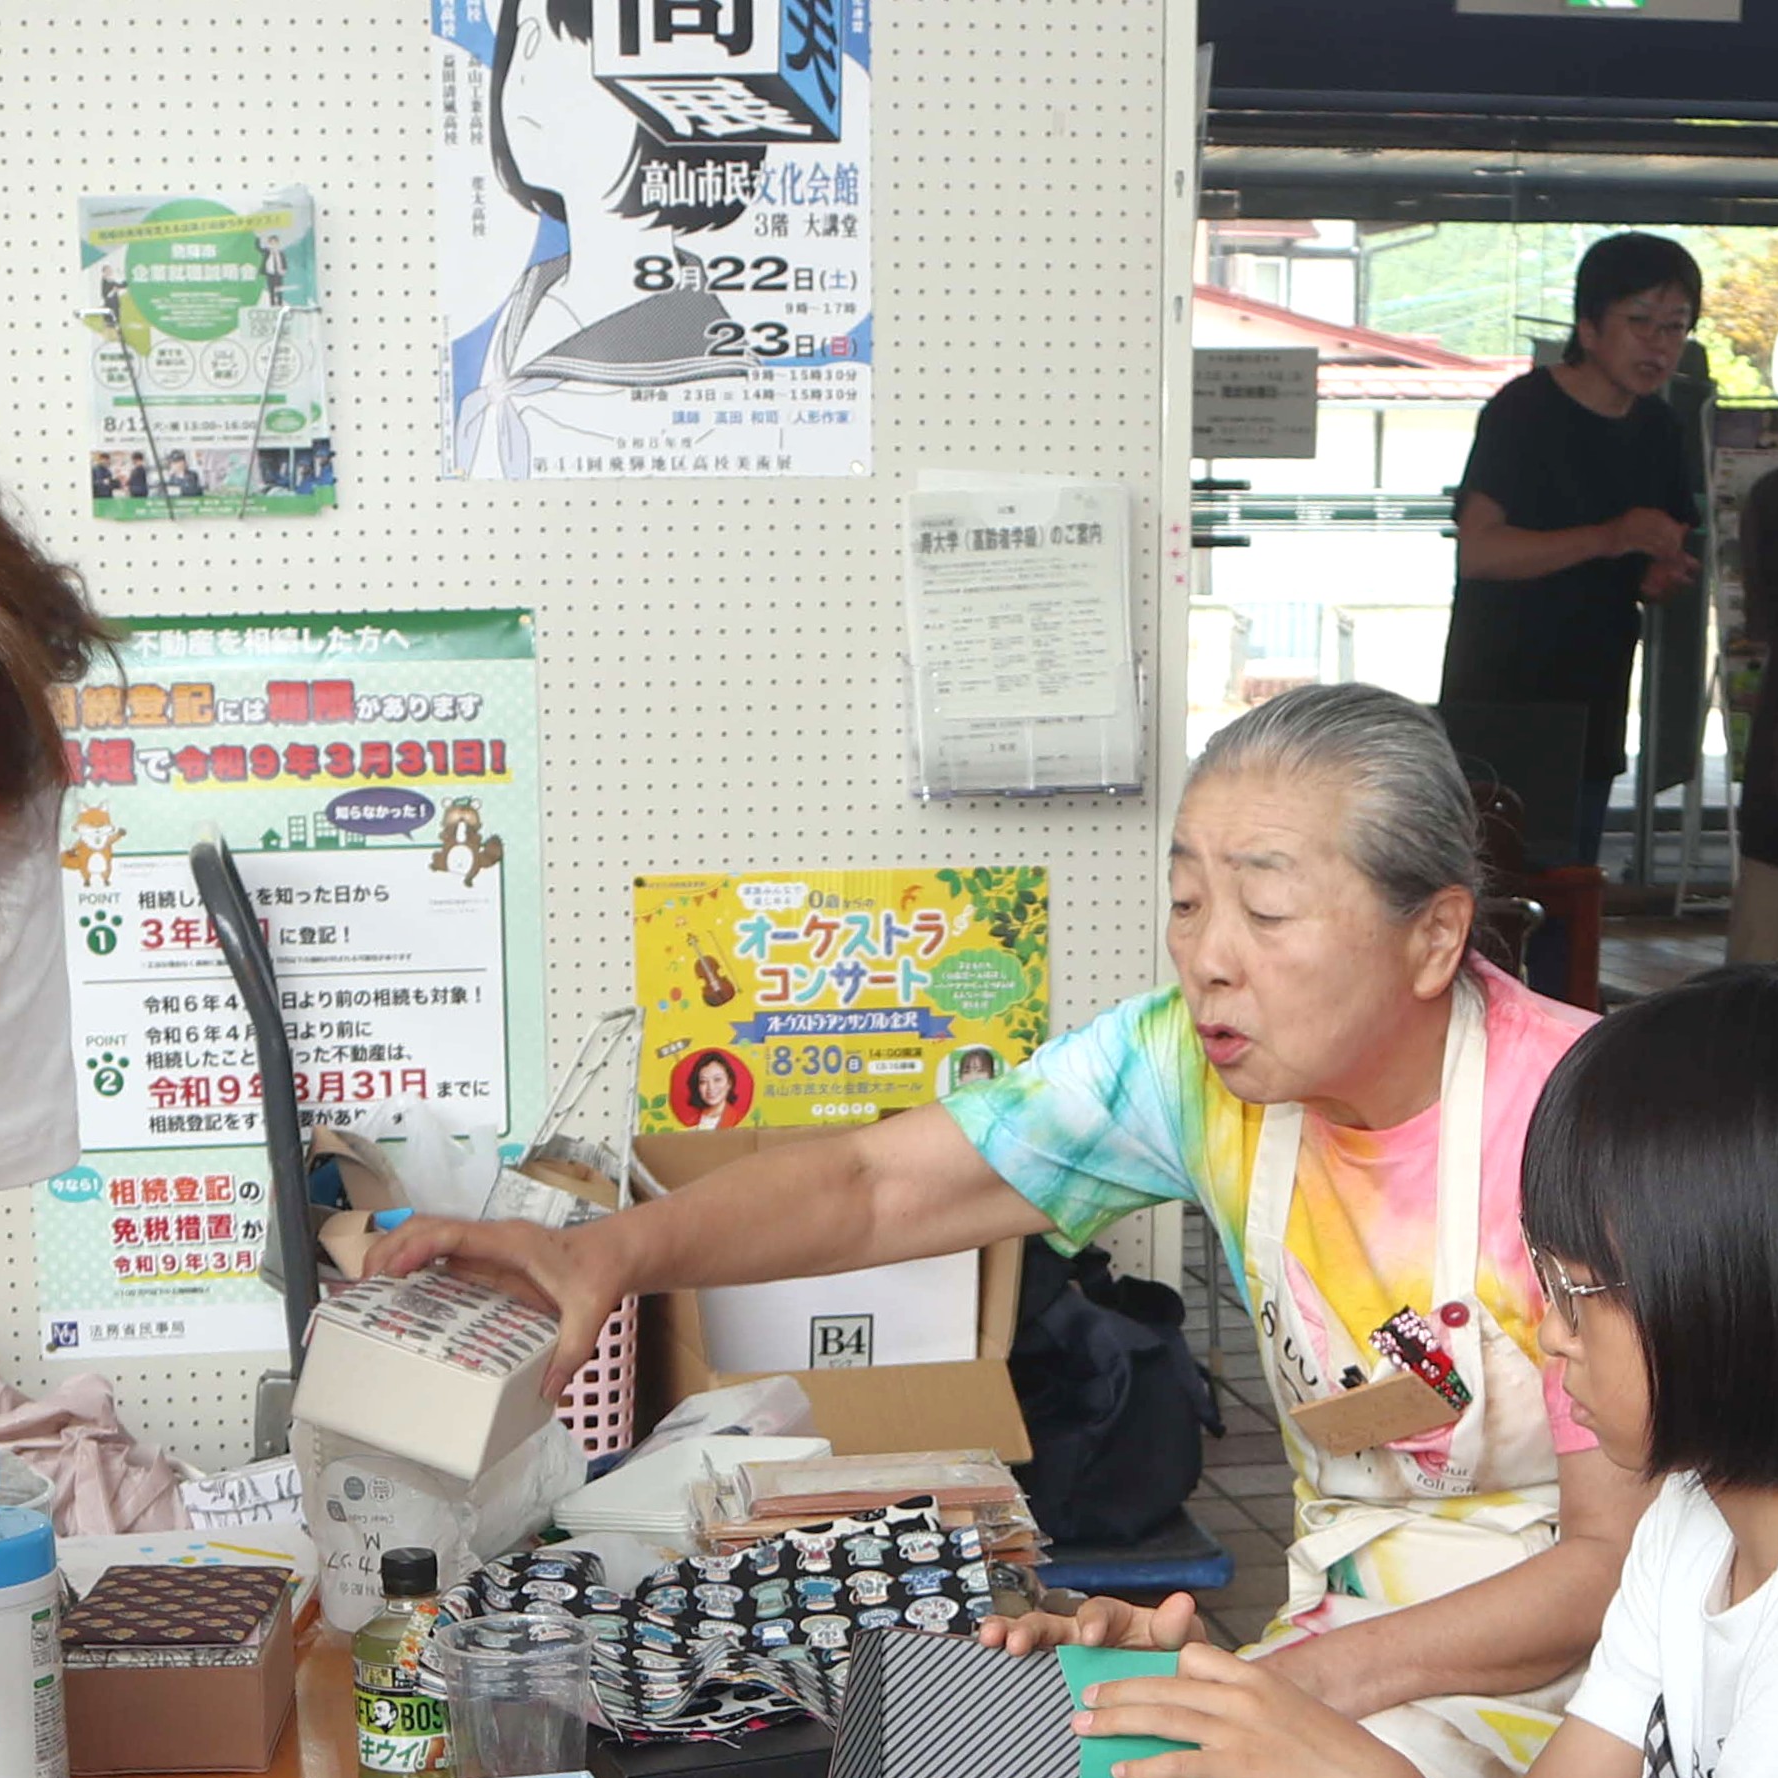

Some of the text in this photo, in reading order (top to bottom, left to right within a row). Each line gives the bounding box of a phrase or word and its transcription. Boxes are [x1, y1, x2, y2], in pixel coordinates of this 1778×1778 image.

[640, 159, 859, 209] 高山市民文化会館
[805, 212, 859, 239] 大講堂
[130, 625, 410, 657] 不動産を相続した方へ
[79, 892, 122, 905] POINT
[139, 885, 390, 910] 相続しを知った日から
[95, 931, 108, 952] 1
[738, 912, 947, 958] オーケストラ
[760, 961, 929, 1004] コンサート
[143, 986, 481, 1014] 令和6年4日より前の相続も対象！
[145, 1021, 373, 1047] 令和6年4月日より前に
[766, 1010, 919, 1033] オーケストラアンサンブル金沢
[86, 1034, 127, 1047] POINT
[146, 1043, 413, 1070] 相続したことった不動産は、
[101, 1070, 117, 1091] 2
[437, 1080, 490, 1098] までに
[764, 1082, 924, 1097] 高山市民文化会館大ホール
[109, 1175, 260, 1206] 相続登記の
[112, 1213, 264, 1245] 免税措置が
[113, 1250, 262, 1274] 令和9年3月
[90, 1320, 185, 1337] 法務省民事局
[817, 1325, 867, 1356] B4
[1416, 1472, 1446, 1491] roll
[363, 1532, 381, 1550] M
